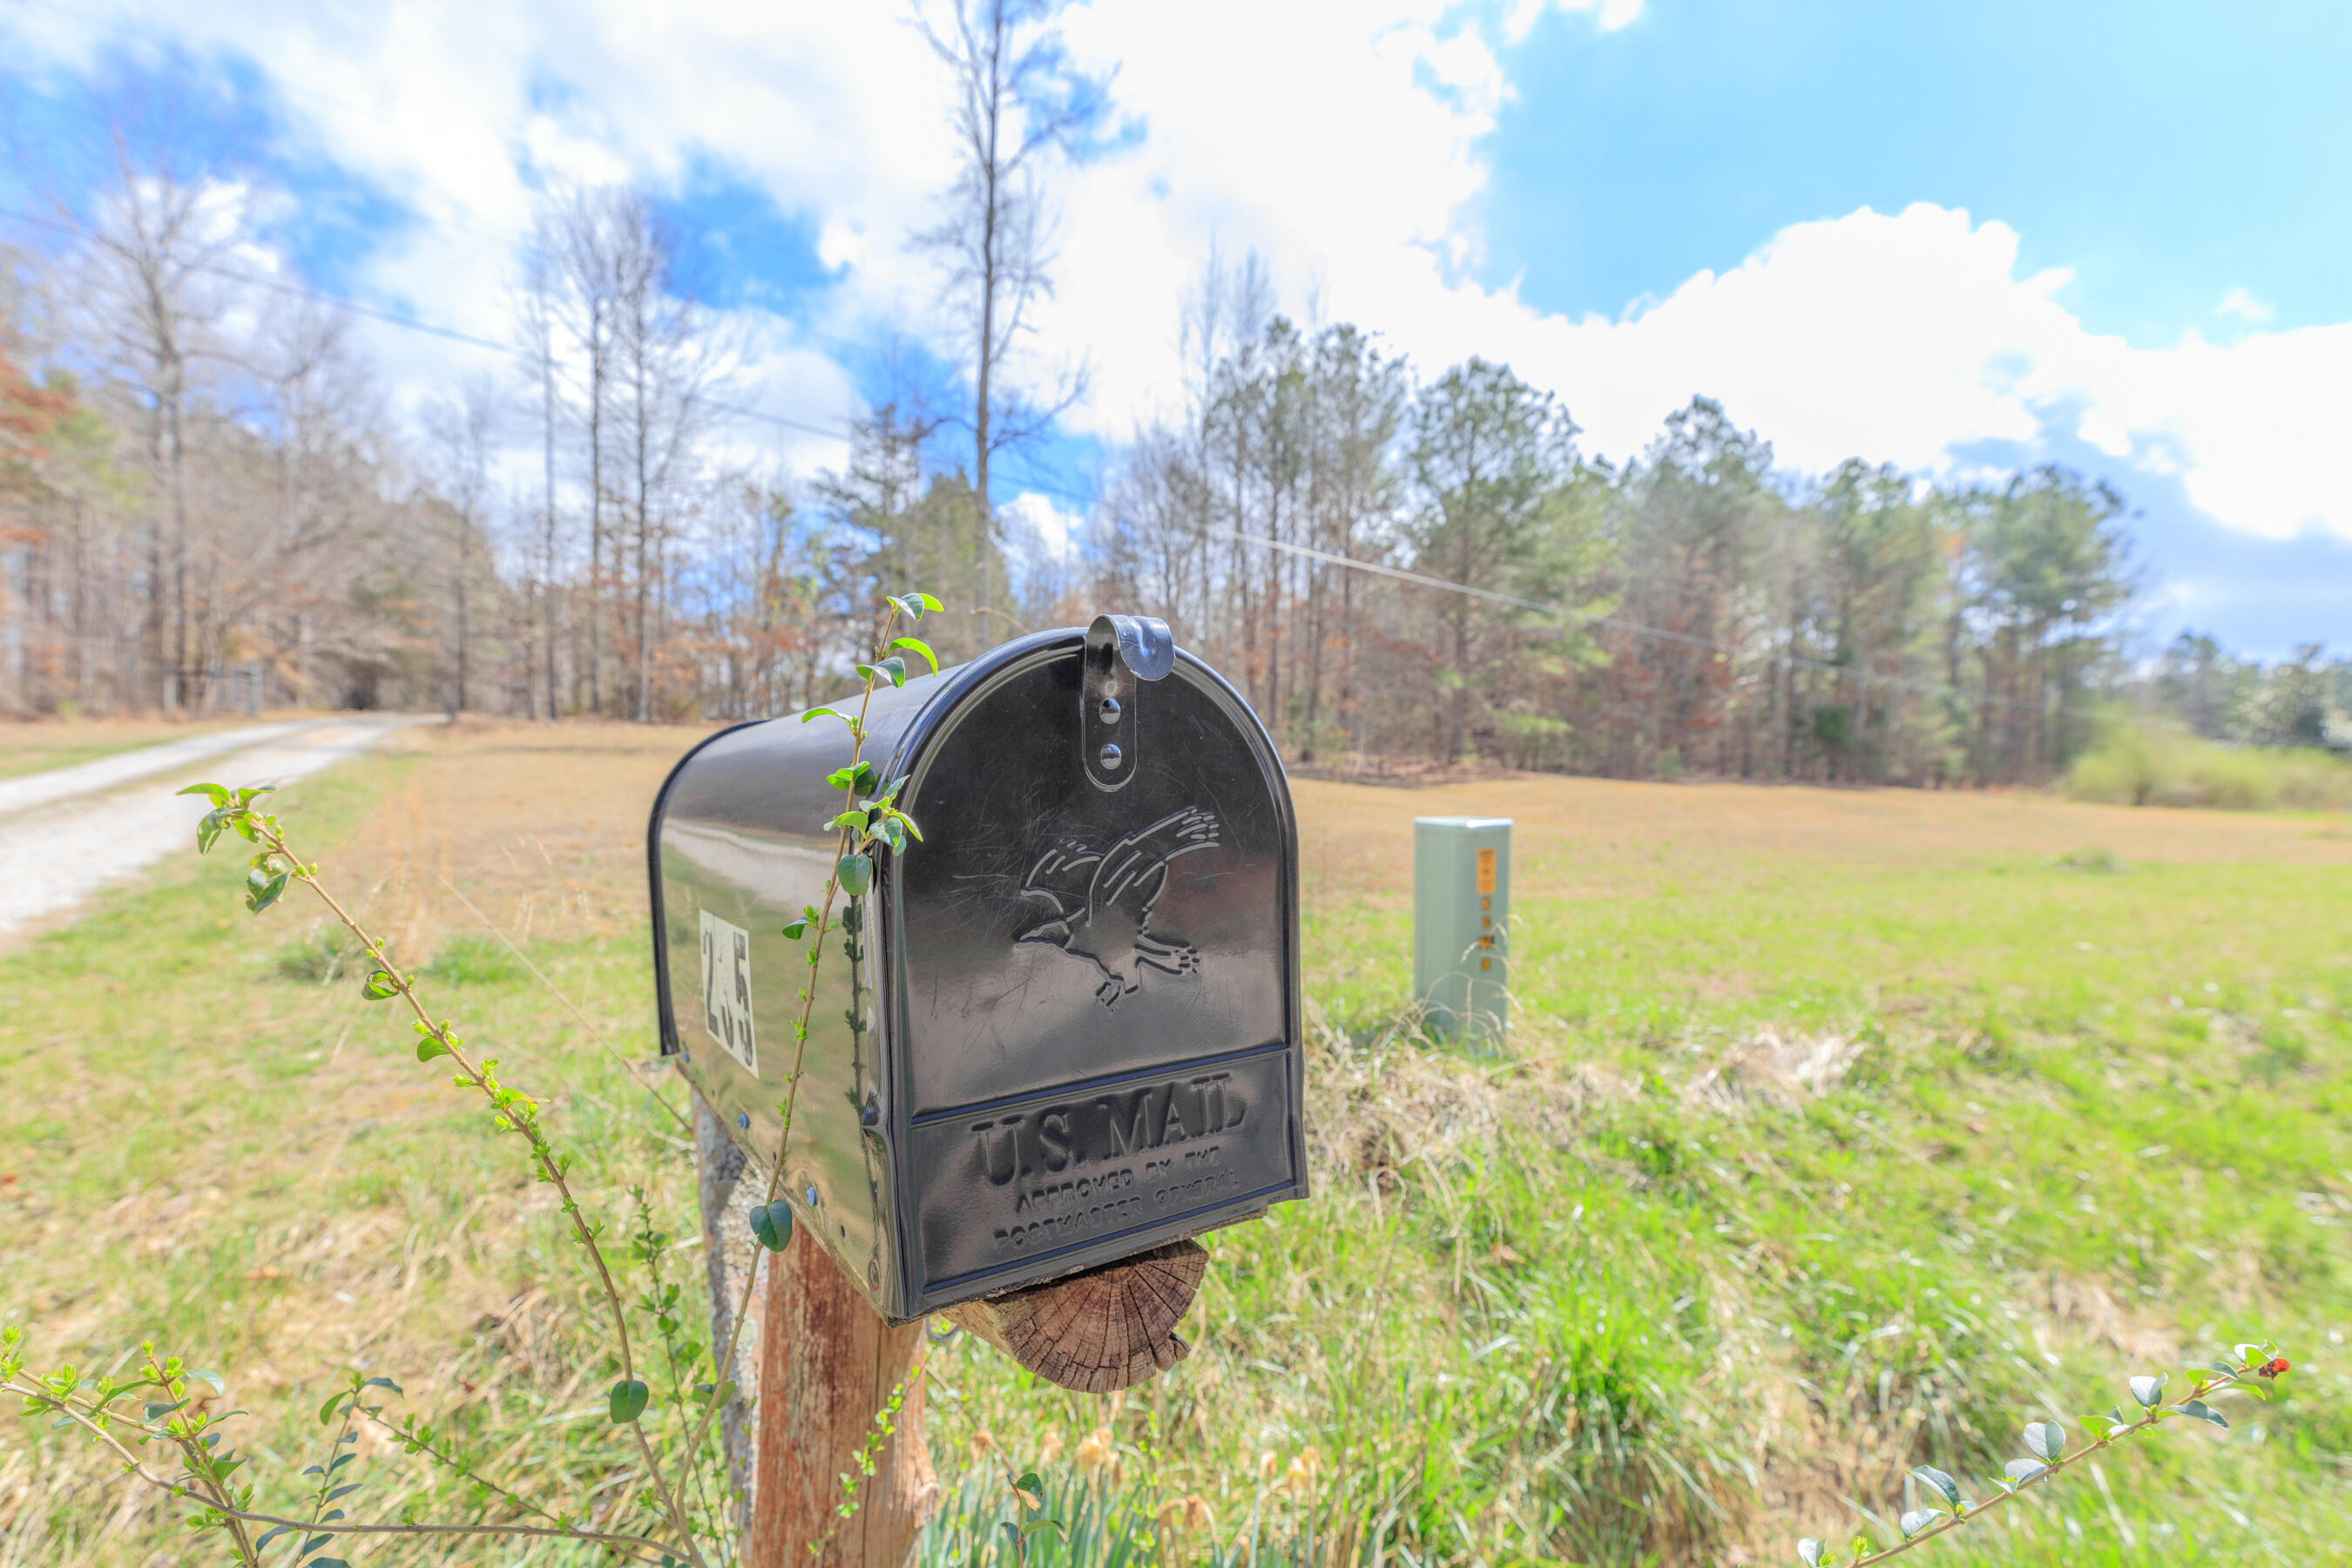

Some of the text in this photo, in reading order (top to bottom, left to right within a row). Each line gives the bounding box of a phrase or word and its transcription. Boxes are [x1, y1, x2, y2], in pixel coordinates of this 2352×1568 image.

[970, 1071, 1247, 1190] U.S. MAIL
[1014, 1146, 1220, 1215] APPROVED BY THE
[993, 1195, 1143, 1250] POSTMASTER
